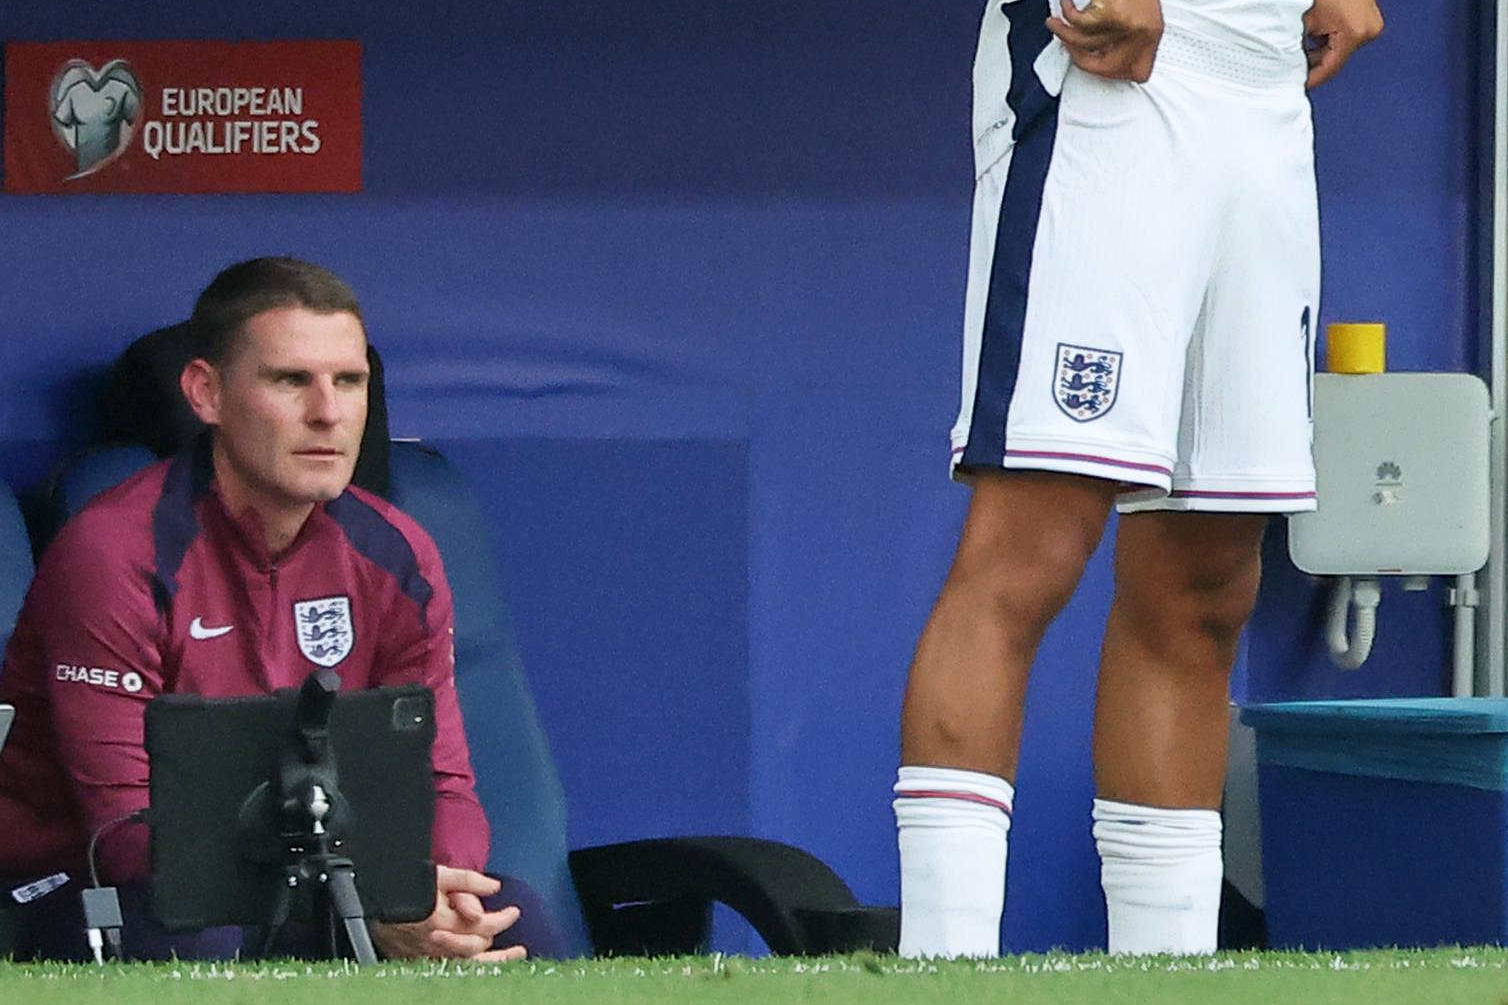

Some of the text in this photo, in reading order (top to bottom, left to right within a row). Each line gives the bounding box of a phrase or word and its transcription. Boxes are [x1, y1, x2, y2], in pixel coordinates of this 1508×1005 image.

[162, 87, 303, 116] EUROPEAN
[143, 120, 321, 160] QUALIFIERS
[56, 664, 119, 688] CHASE
